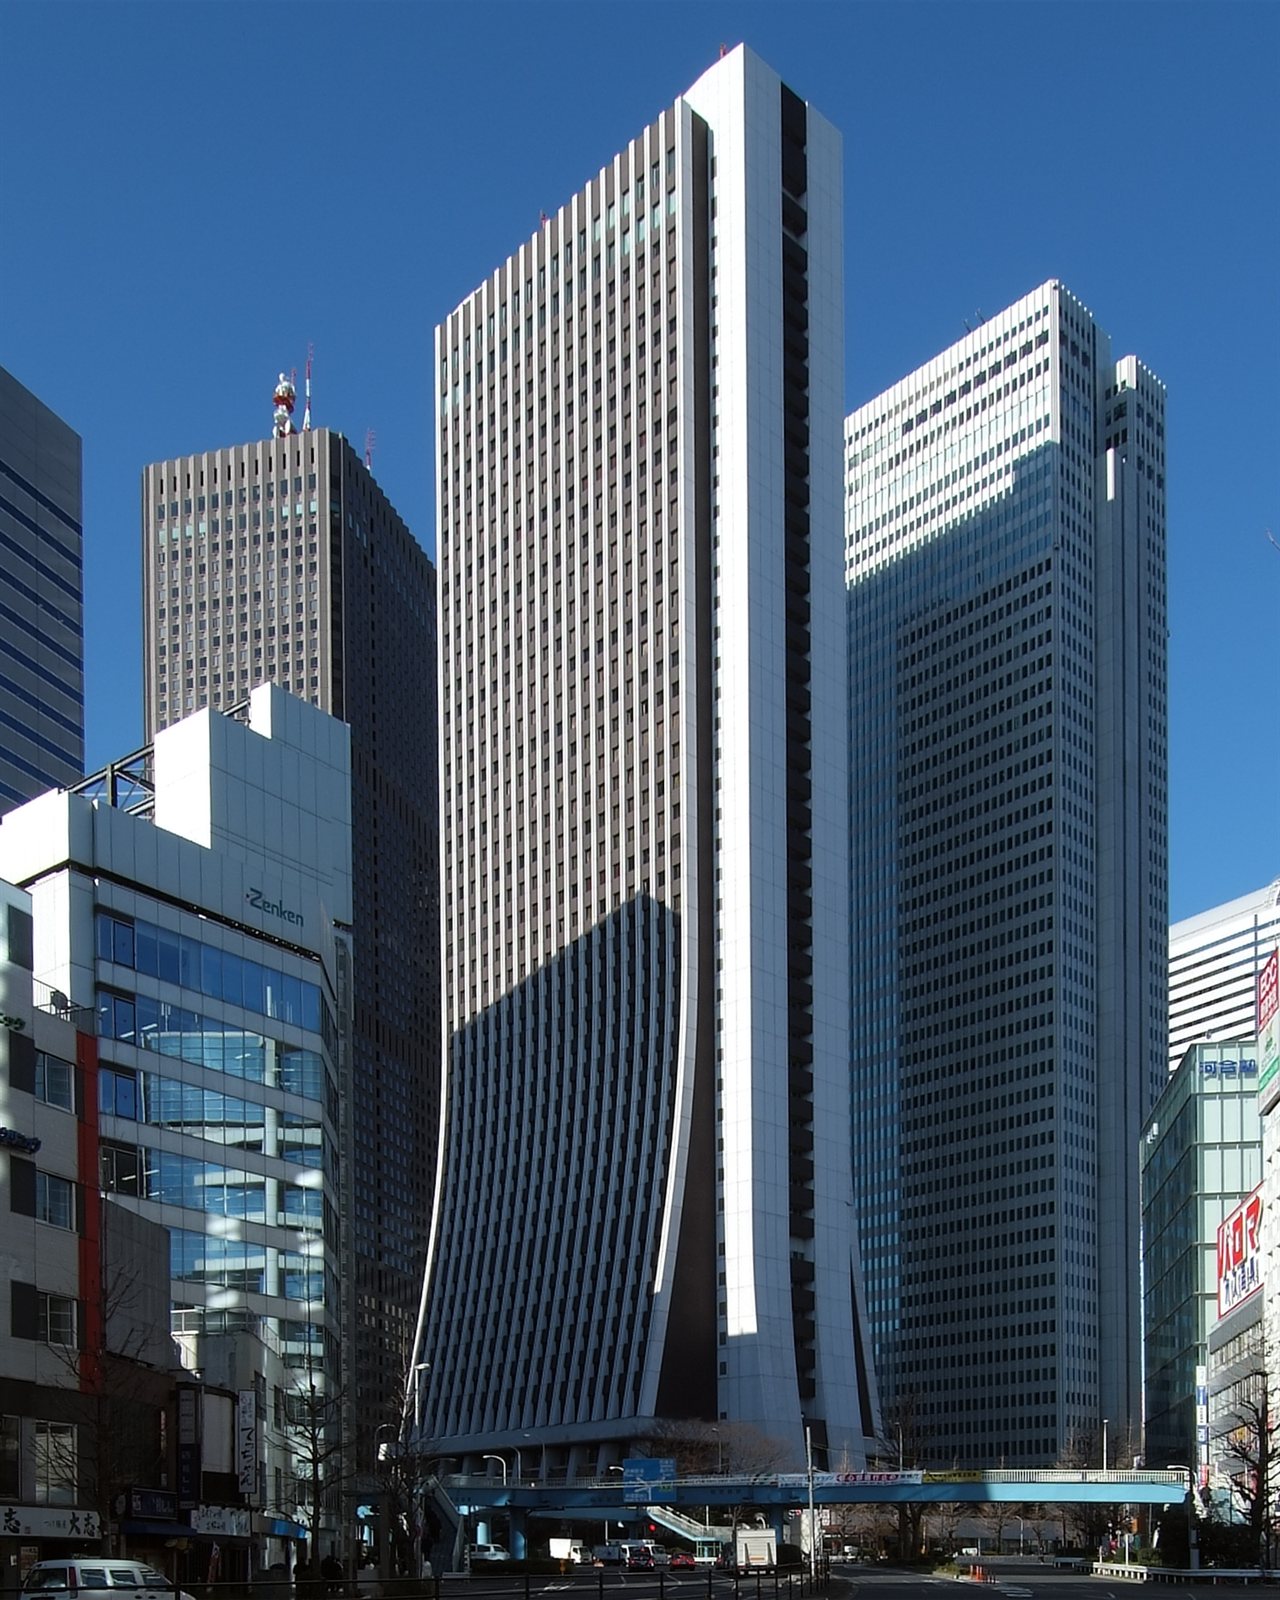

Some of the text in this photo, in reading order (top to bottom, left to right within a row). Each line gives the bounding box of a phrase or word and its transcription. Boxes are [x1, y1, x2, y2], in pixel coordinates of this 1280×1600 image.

[248, 887, 304, 928] Zenken
[1218, 1195, 1262, 1281] パロマ
